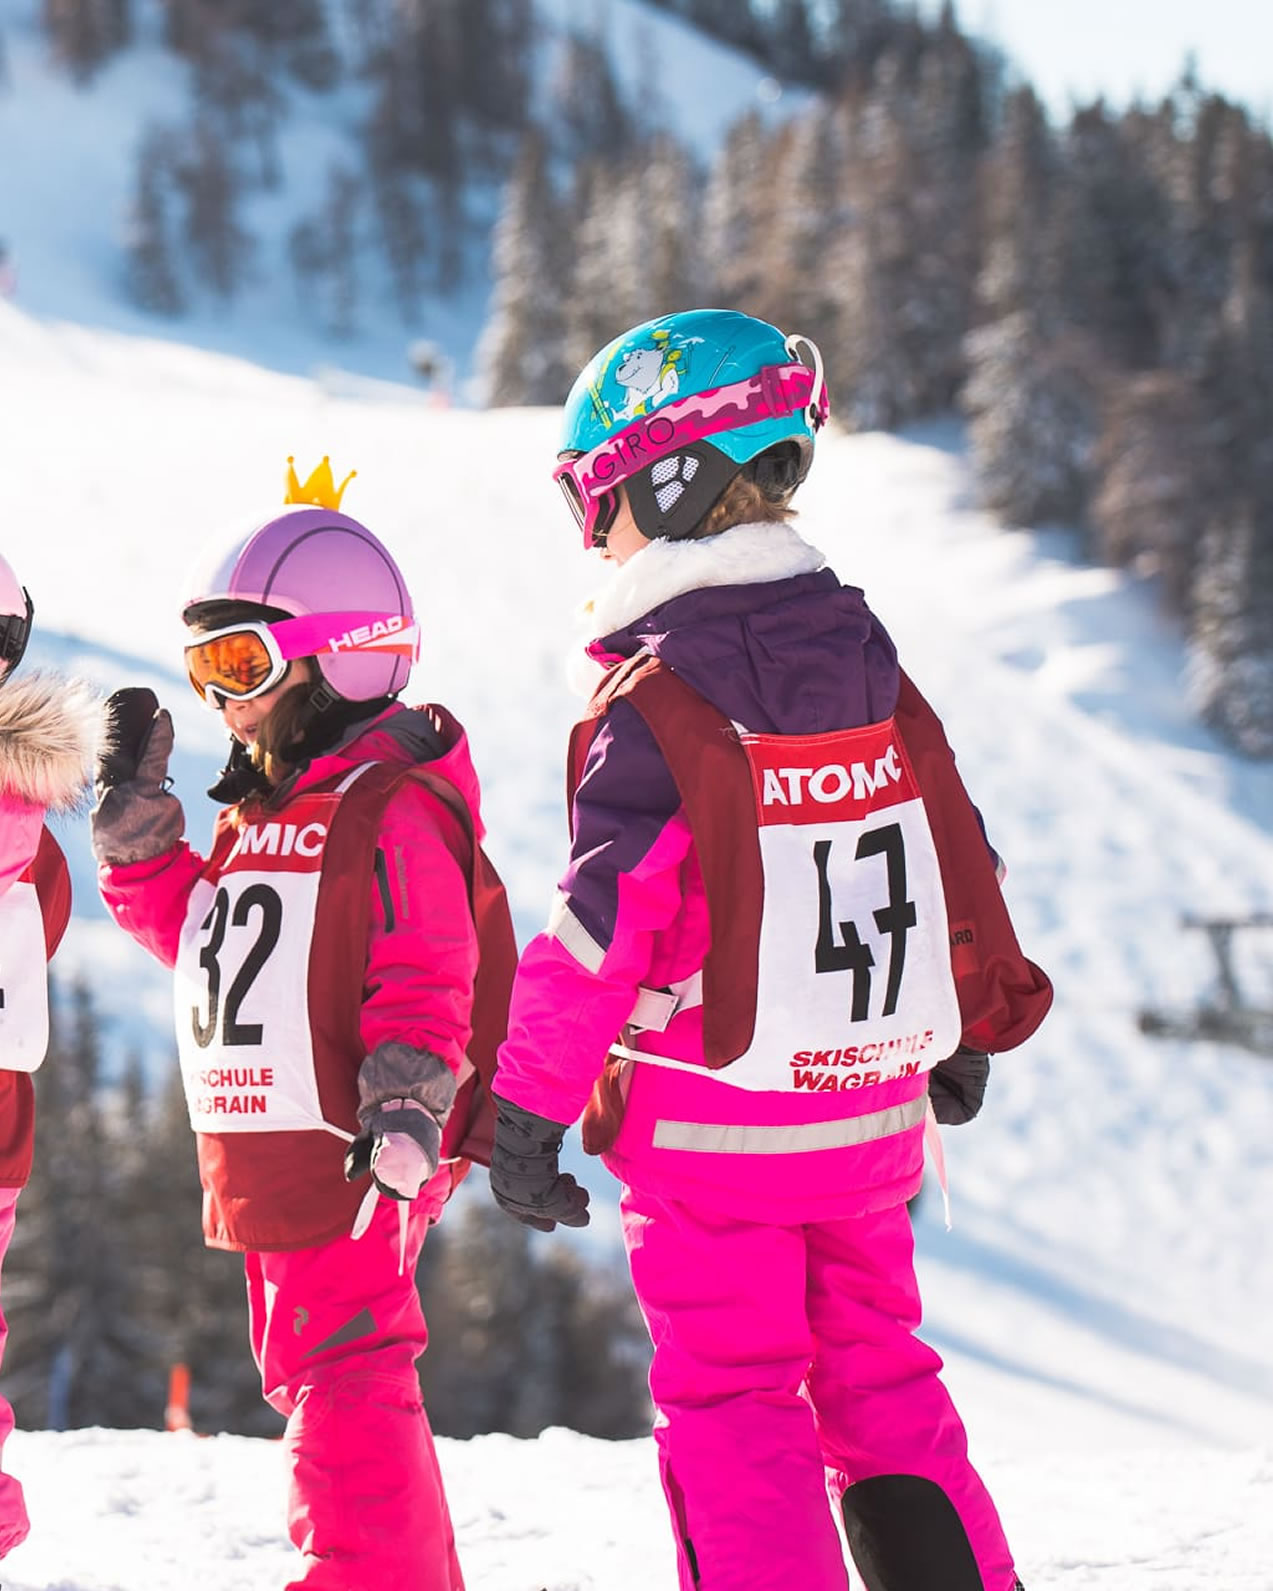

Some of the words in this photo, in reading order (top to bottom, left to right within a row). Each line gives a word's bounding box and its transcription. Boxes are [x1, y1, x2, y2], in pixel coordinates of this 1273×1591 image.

[592, 417, 675, 480] GIRO
[329, 615, 403, 653] HEAD
[763, 744, 902, 806] ATOMC
[239, 822, 327, 857] MIC
[813, 823, 917, 1022] 47
[191, 883, 283, 1049] 32
[789, 1029, 934, 1067] SKISCE
